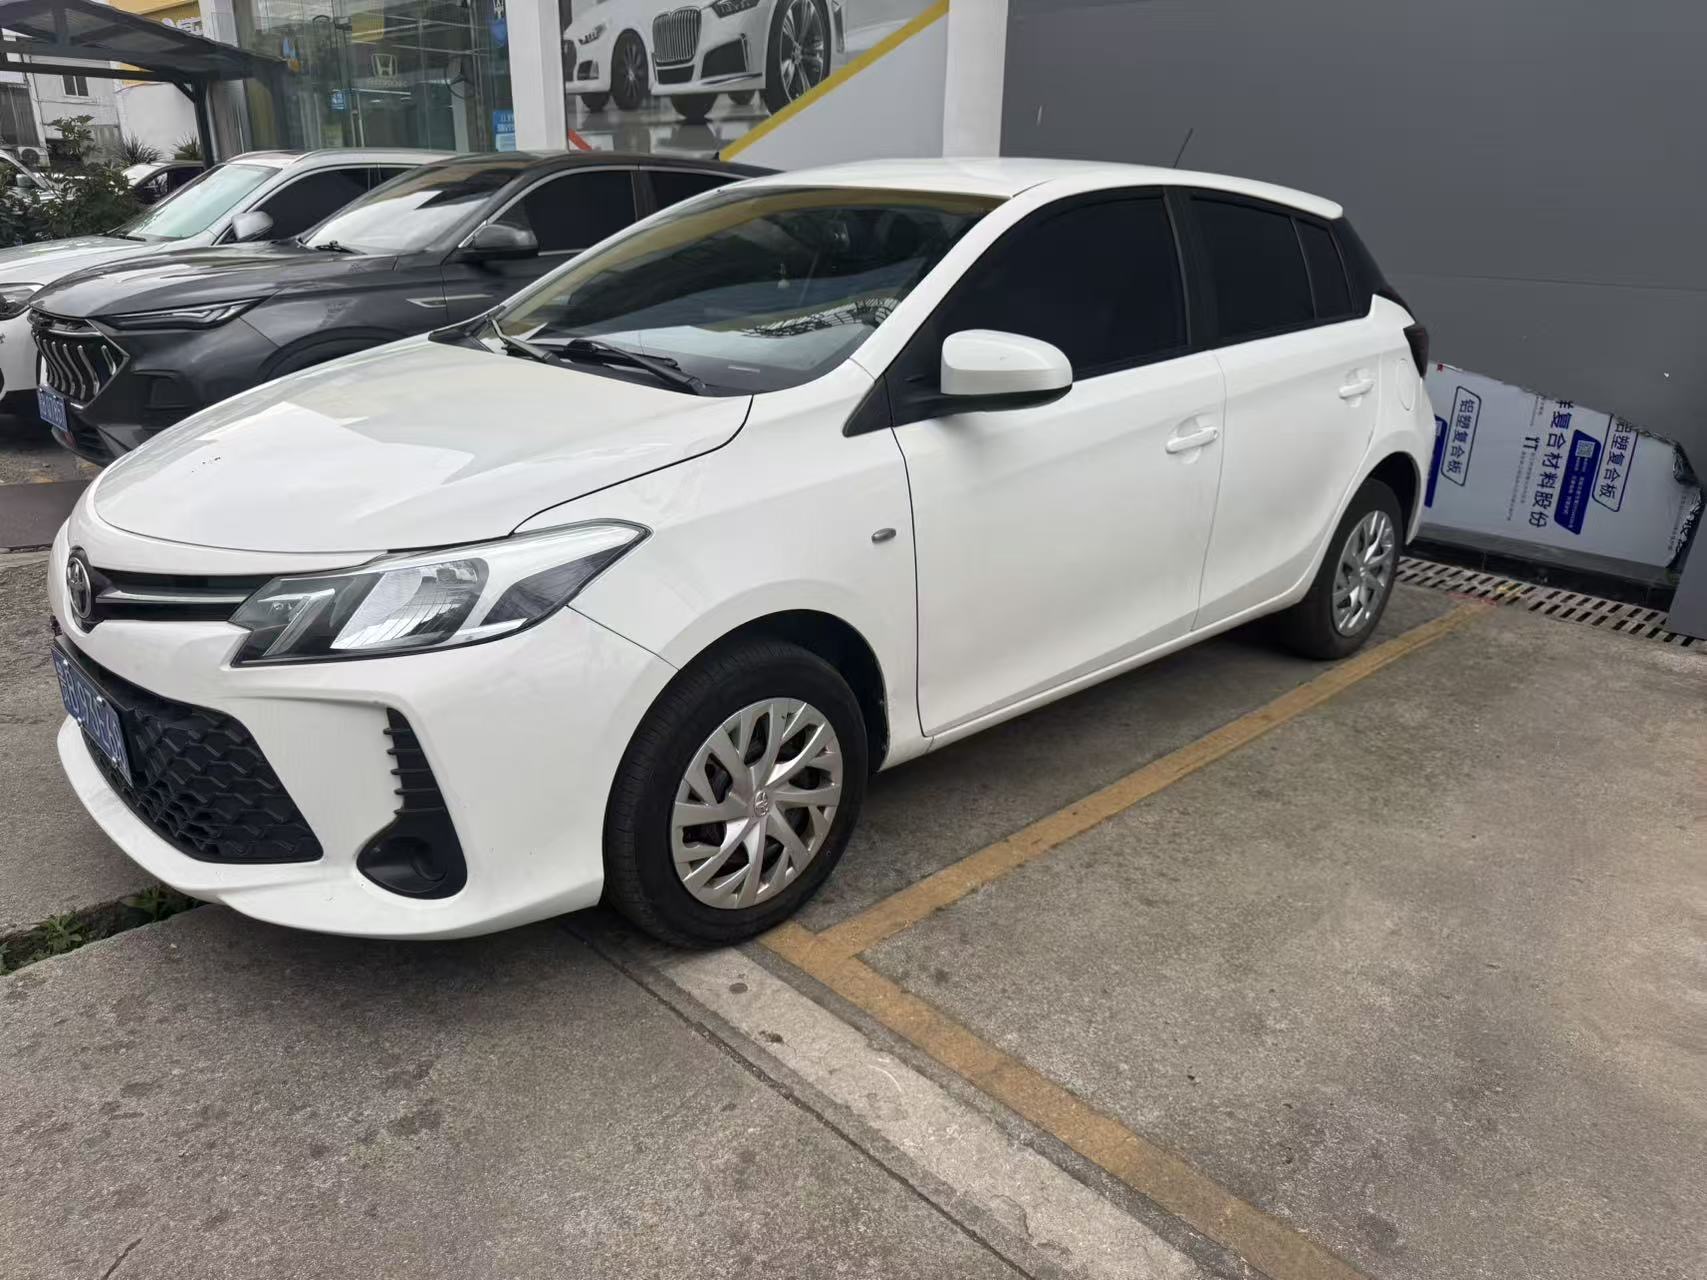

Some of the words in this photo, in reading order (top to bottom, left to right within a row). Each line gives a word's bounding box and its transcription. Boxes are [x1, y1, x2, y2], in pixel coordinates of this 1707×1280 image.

[1446, 399, 1475, 475] 铝塑复合板
